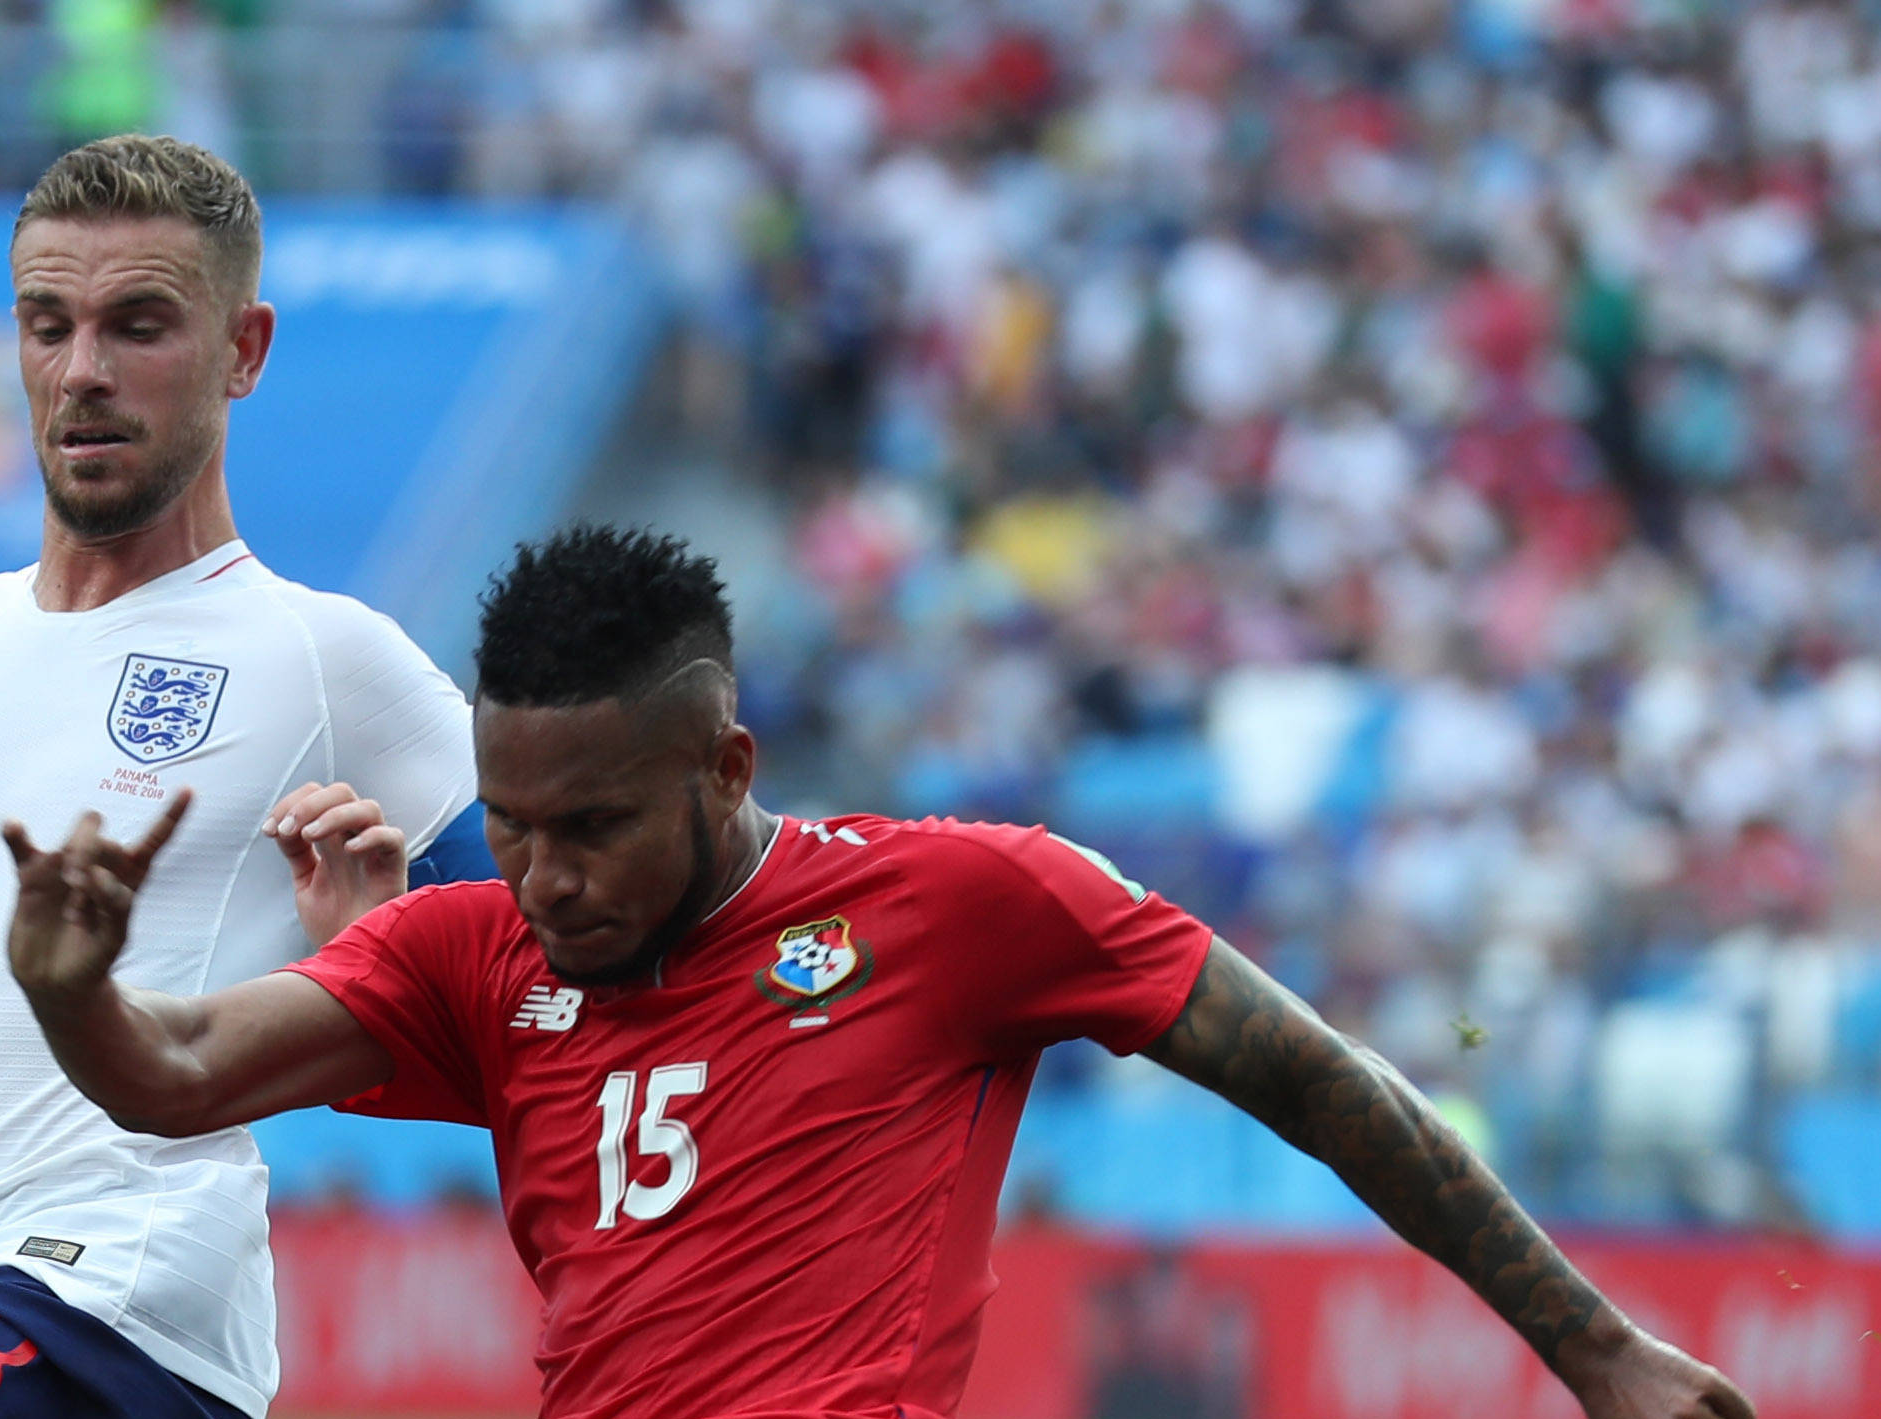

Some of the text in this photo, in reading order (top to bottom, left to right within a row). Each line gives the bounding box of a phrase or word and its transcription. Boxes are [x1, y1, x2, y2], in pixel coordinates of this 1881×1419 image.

[99, 777, 165, 800] 24 JUNE 2018
[113, 767, 159, 787] PANAMA
[594, 1061, 708, 1230] 15
